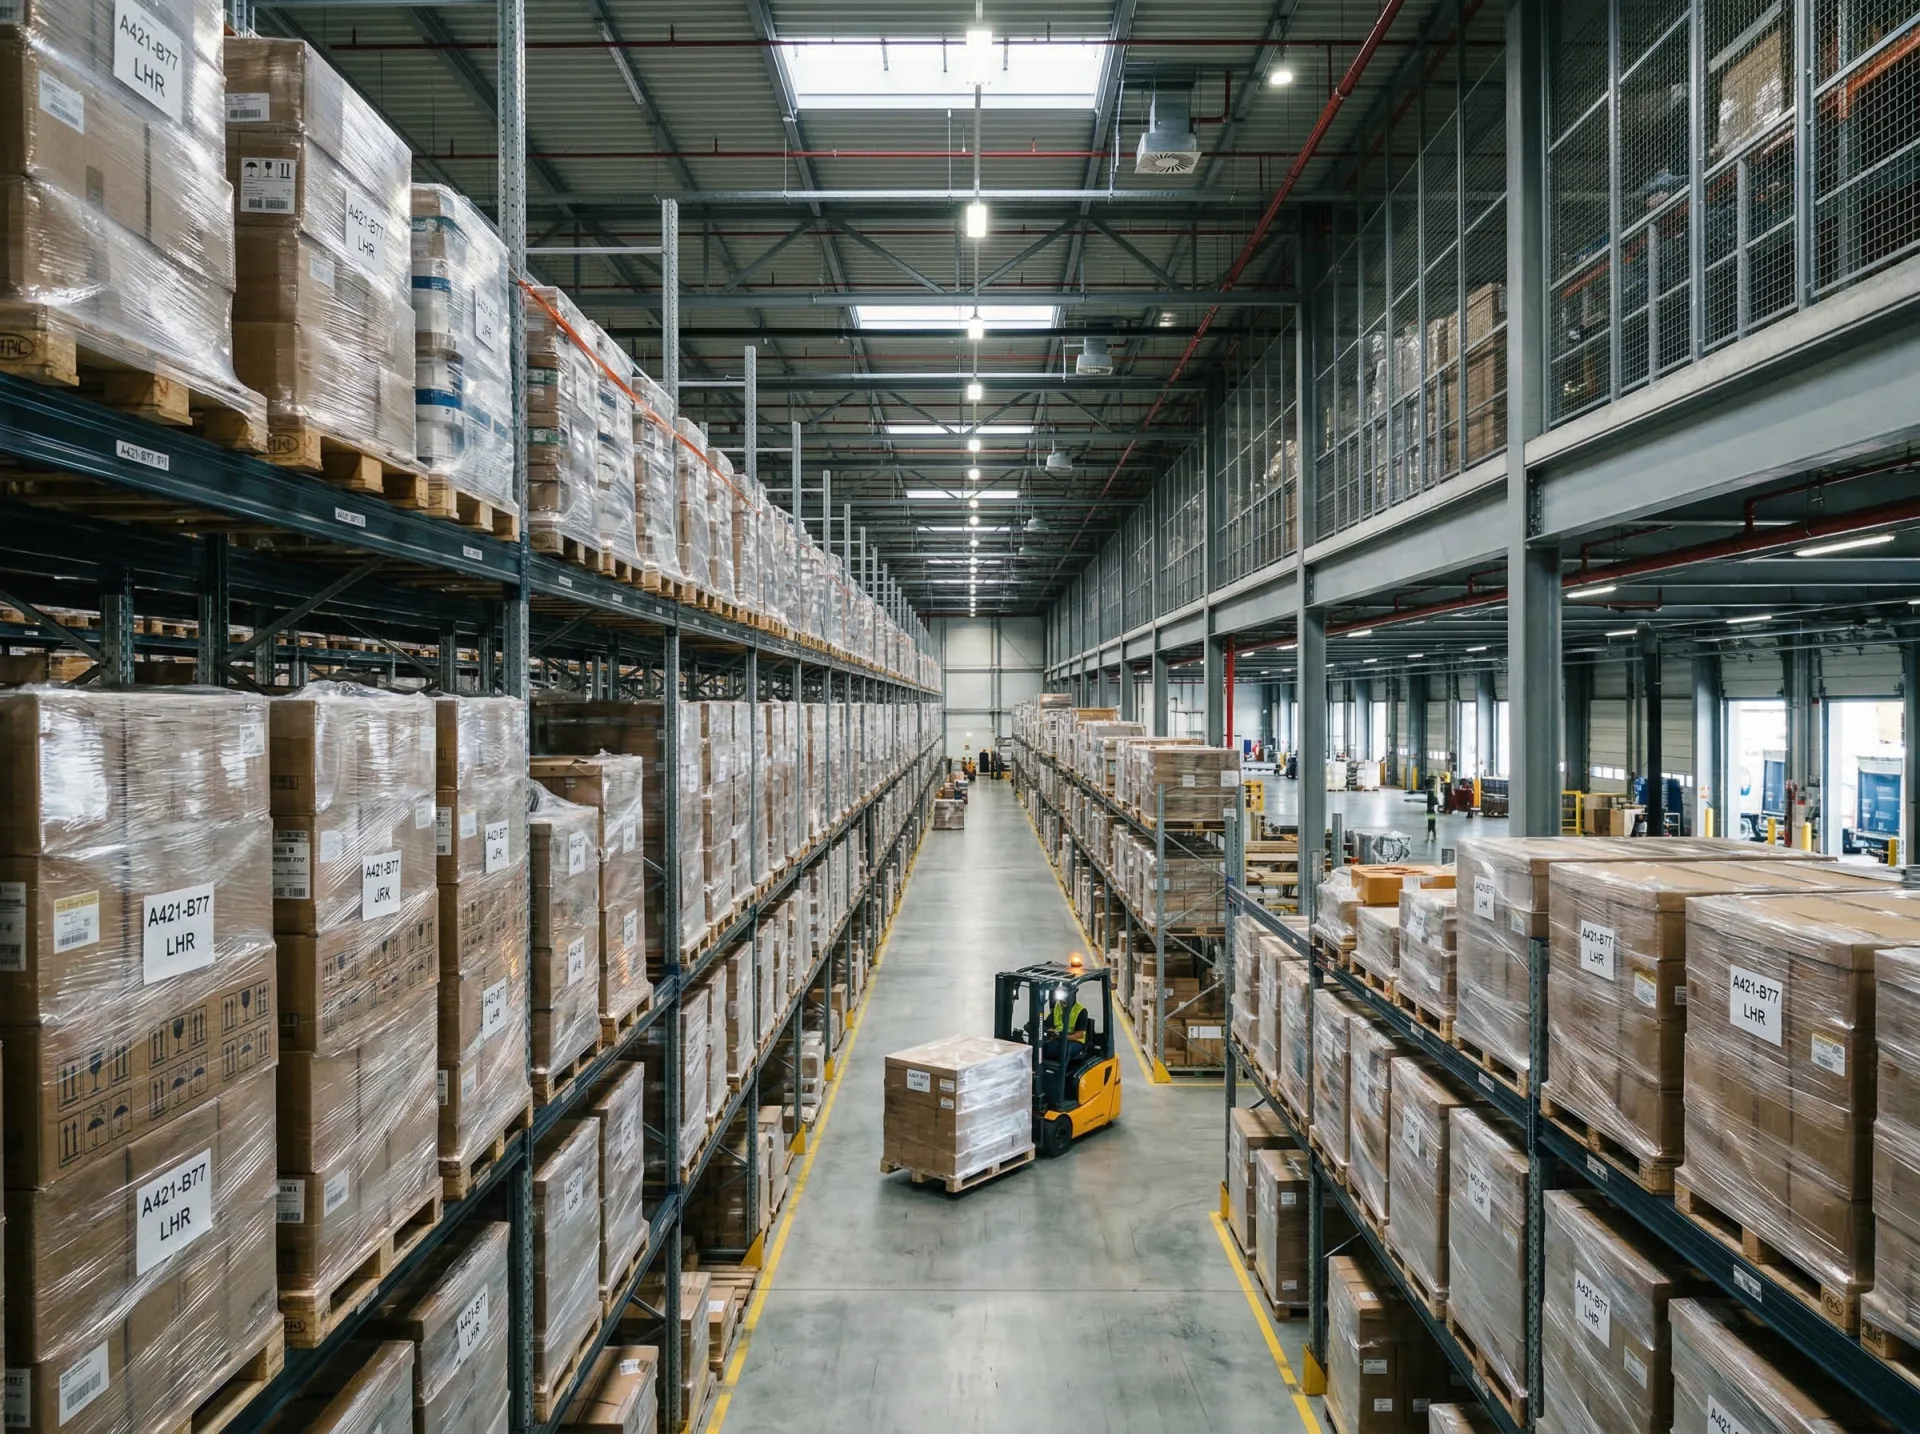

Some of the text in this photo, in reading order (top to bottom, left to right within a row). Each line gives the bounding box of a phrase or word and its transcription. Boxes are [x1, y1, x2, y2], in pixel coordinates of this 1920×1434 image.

[119, 14, 178, 71] A421-B77
[134, 57, 165, 98] LHR
[347, 203, 384, 241] A421-B77
[357, 234, 375, 260] LHR
[365, 859, 399, 879] A421-B77
[147, 894, 210, 928] A421-B77
[166, 931, 196, 957] LHR
[1582, 927, 1613, 948] A421-B77
[1589, 949, 1605, 967] LHR
[1732, 974, 1779, 1004] A421-B77
[1743, 1002, 1766, 1026] LHR
[141, 1162, 206, 1218] A421-B77
[160, 1206, 191, 1241] LHR
[1584, 1304, 1600, 1330] LHR
